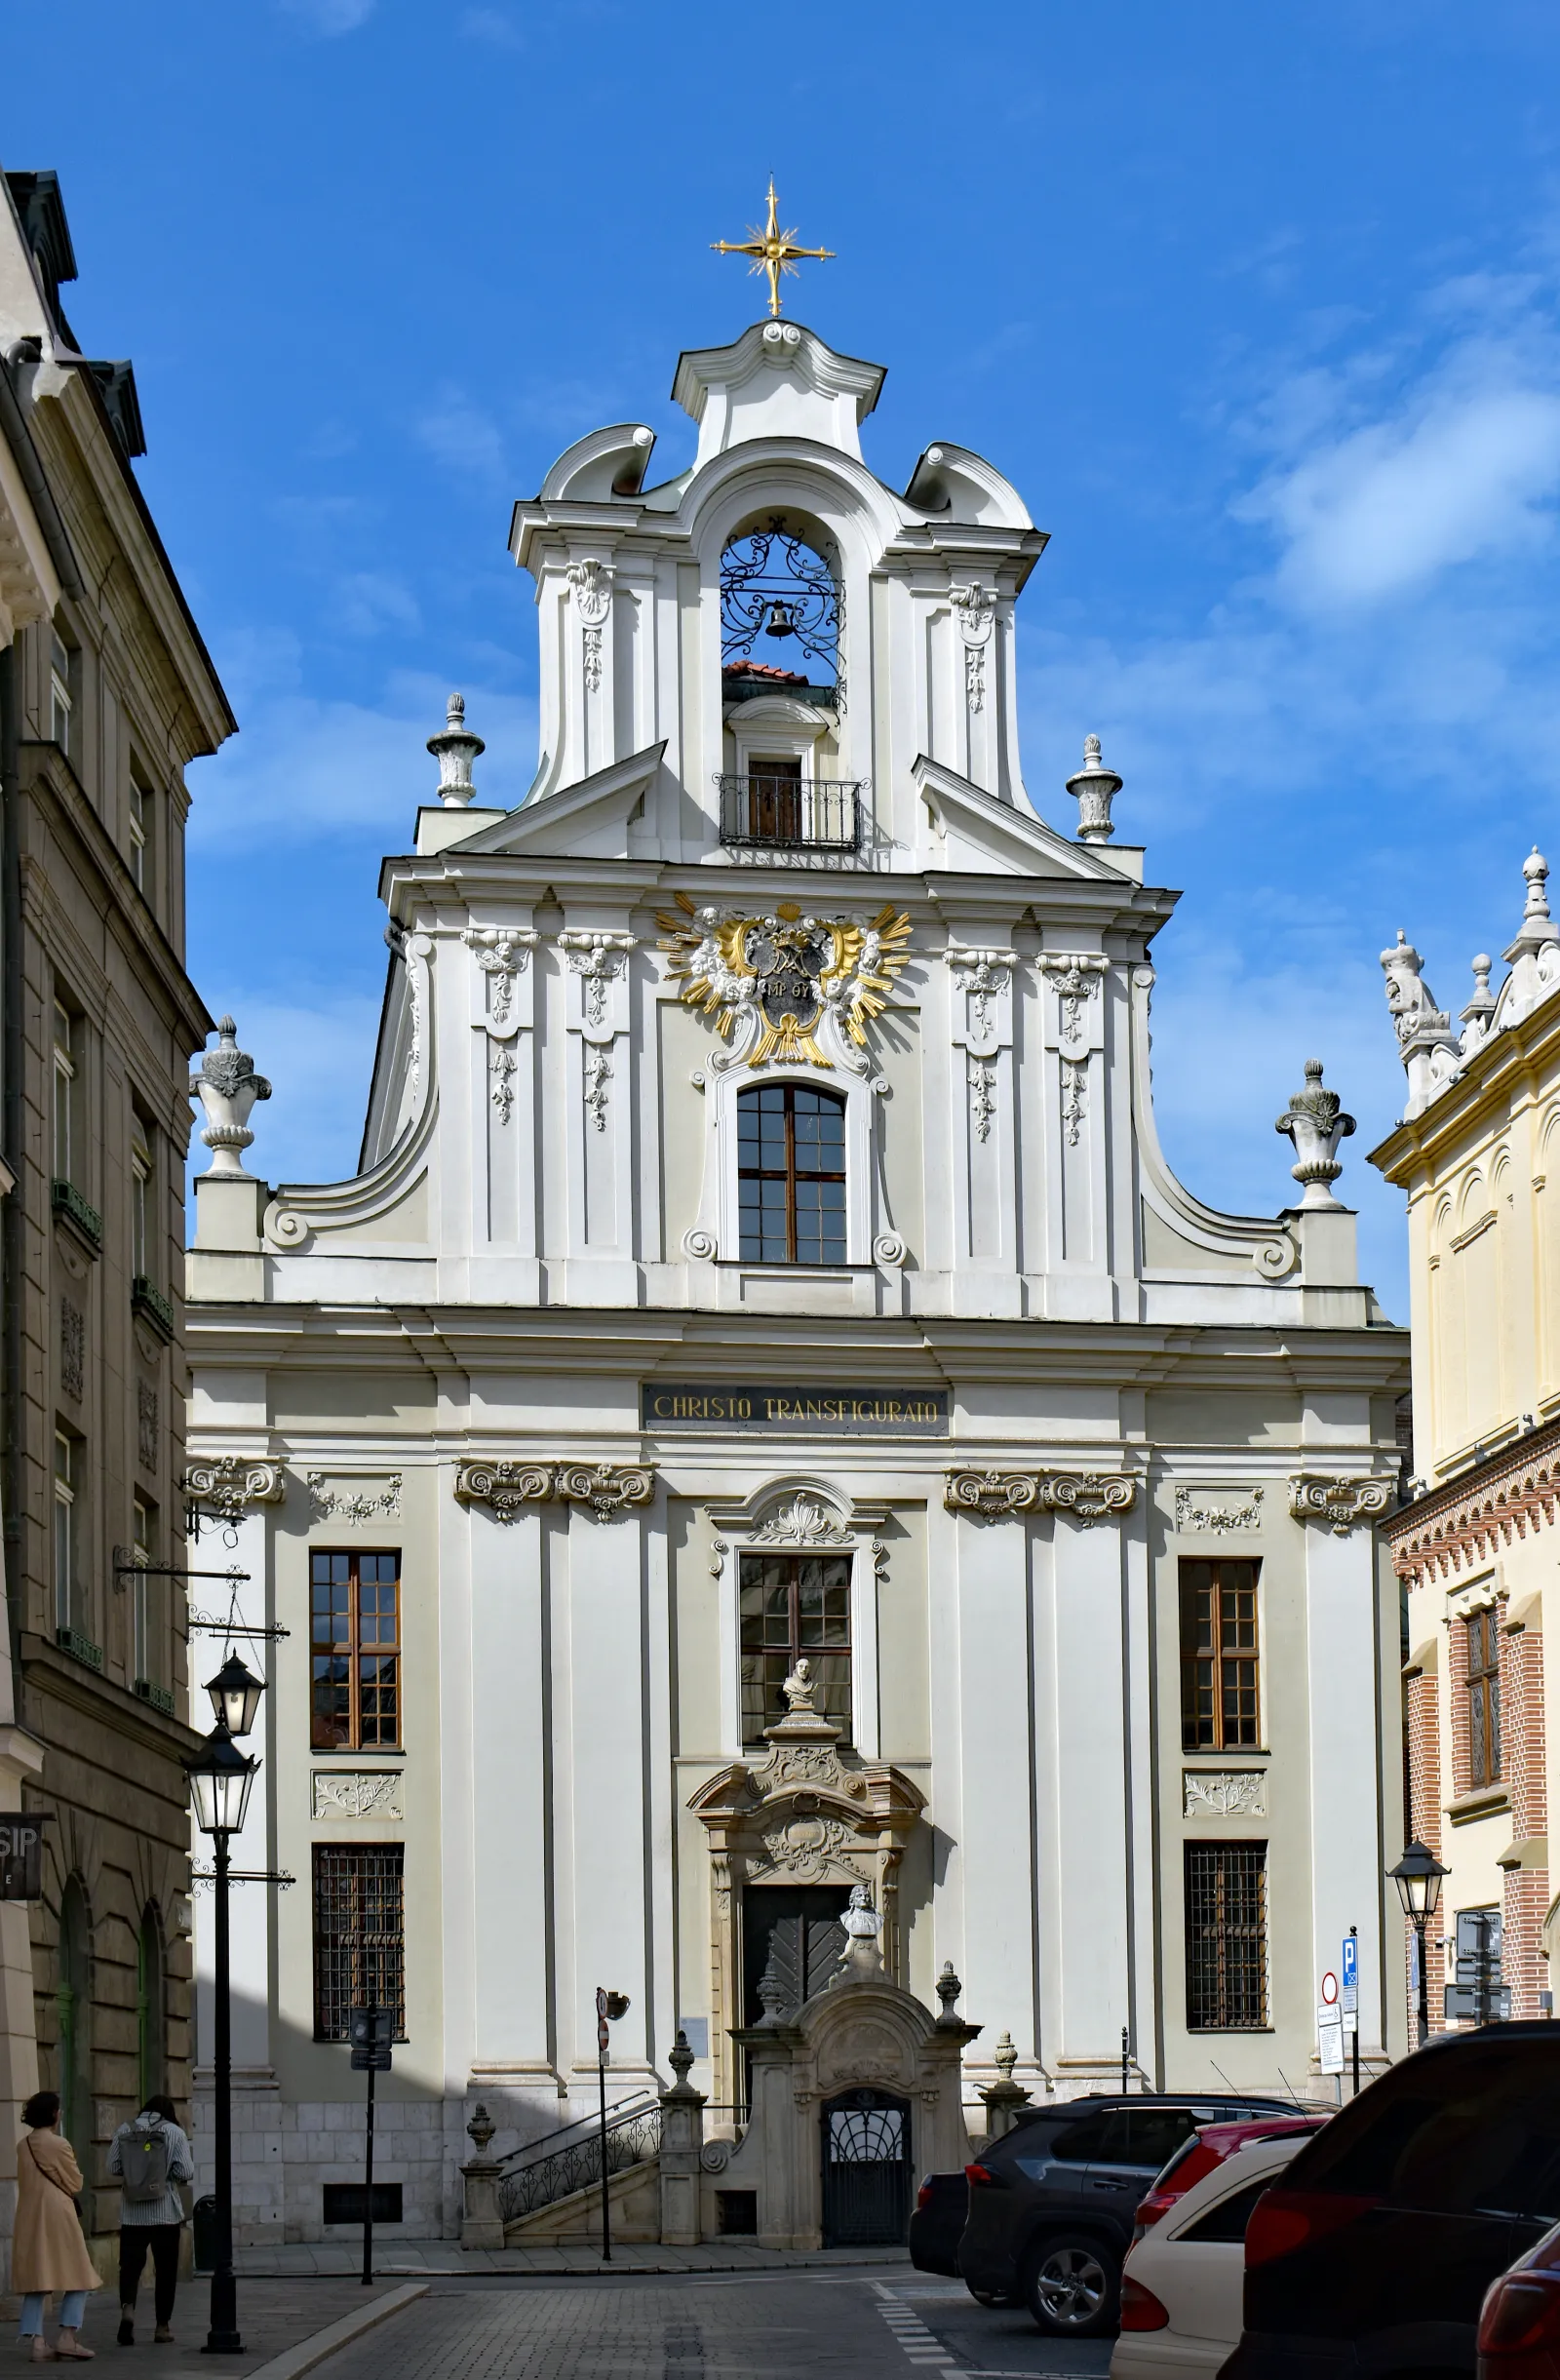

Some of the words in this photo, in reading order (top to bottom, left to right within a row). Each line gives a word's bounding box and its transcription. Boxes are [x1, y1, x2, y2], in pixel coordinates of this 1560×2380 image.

[653, 1396, 751, 1419] CHRISTO
[763, 1398, 938, 1423] TRANSFIGURATO
[1345, 1941, 1354, 1972] P
